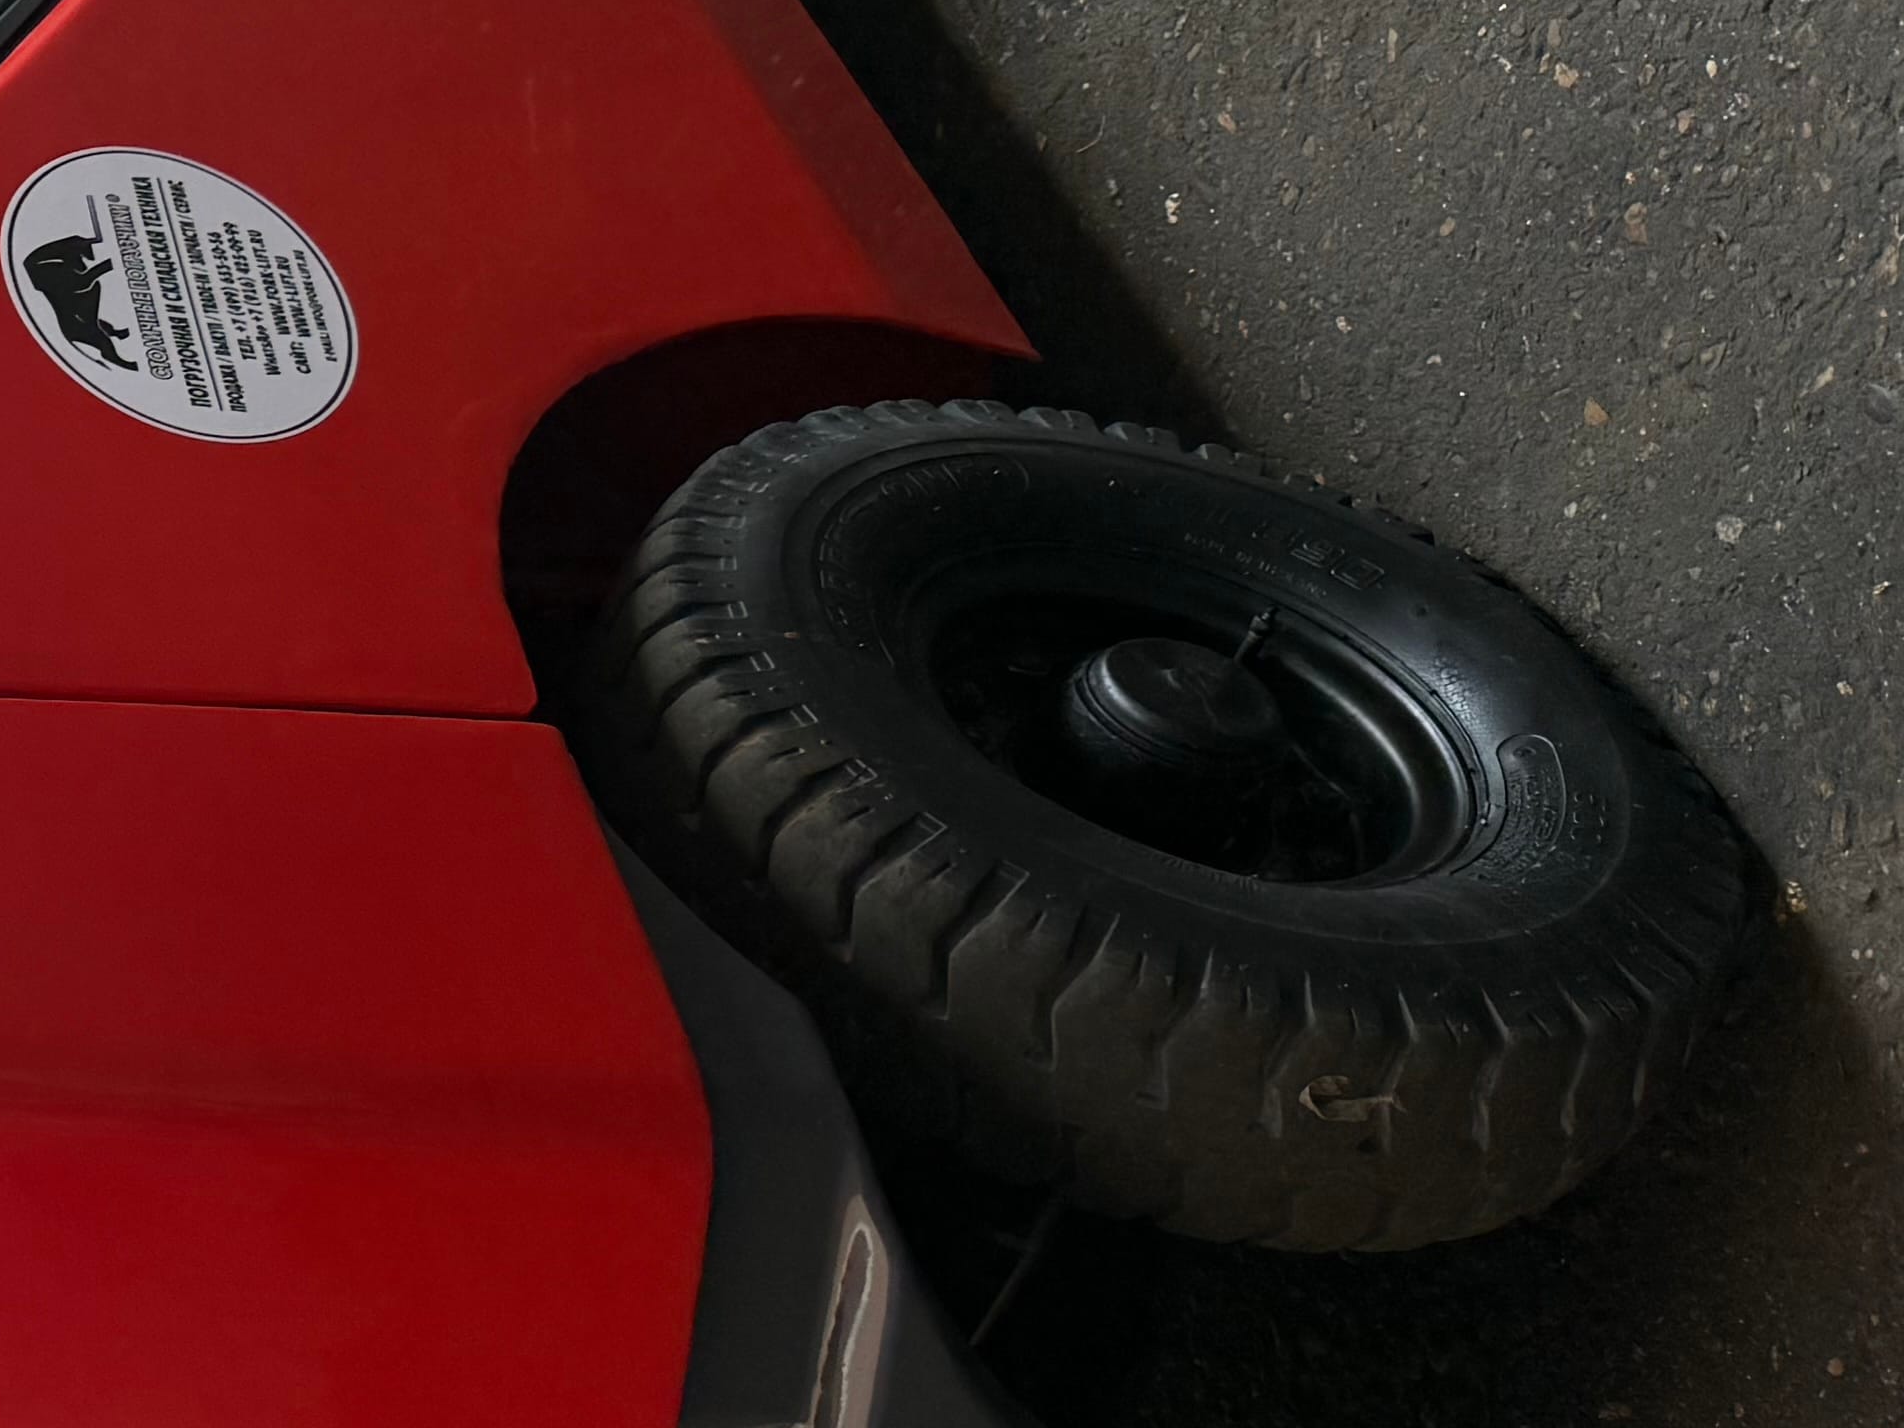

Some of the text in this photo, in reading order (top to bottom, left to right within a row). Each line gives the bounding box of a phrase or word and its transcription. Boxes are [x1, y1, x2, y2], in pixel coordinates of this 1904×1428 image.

[168, 180, 191, 214] СЕРВИС
[179, 220, 206, 266] ЗАПЧАСТИ
[131, 176, 212, 408] ПОГРУЗОЧНАЯ И СКЛАДСКАЯ ТЕХНИКА
[192, 274, 218, 314] TRADE-IN
[238, 277, 262, 306] (916)
[248, 229, 291, 336] WWW.FORK-LIFT.RU
[222, 286, 246, 316] (499)
[249, 308, 264, 322] +7
[131, 292, 174, 380] СТОЛИЧНЫЕ
[206, 322, 231, 356] ВЫКУП
[232, 318, 247, 332] +7
[238, 336, 257, 360] ТЕЛ.
[290, 340, 311, 374] САЙТ:
[218, 364, 247, 412] ПРОДАЖА
